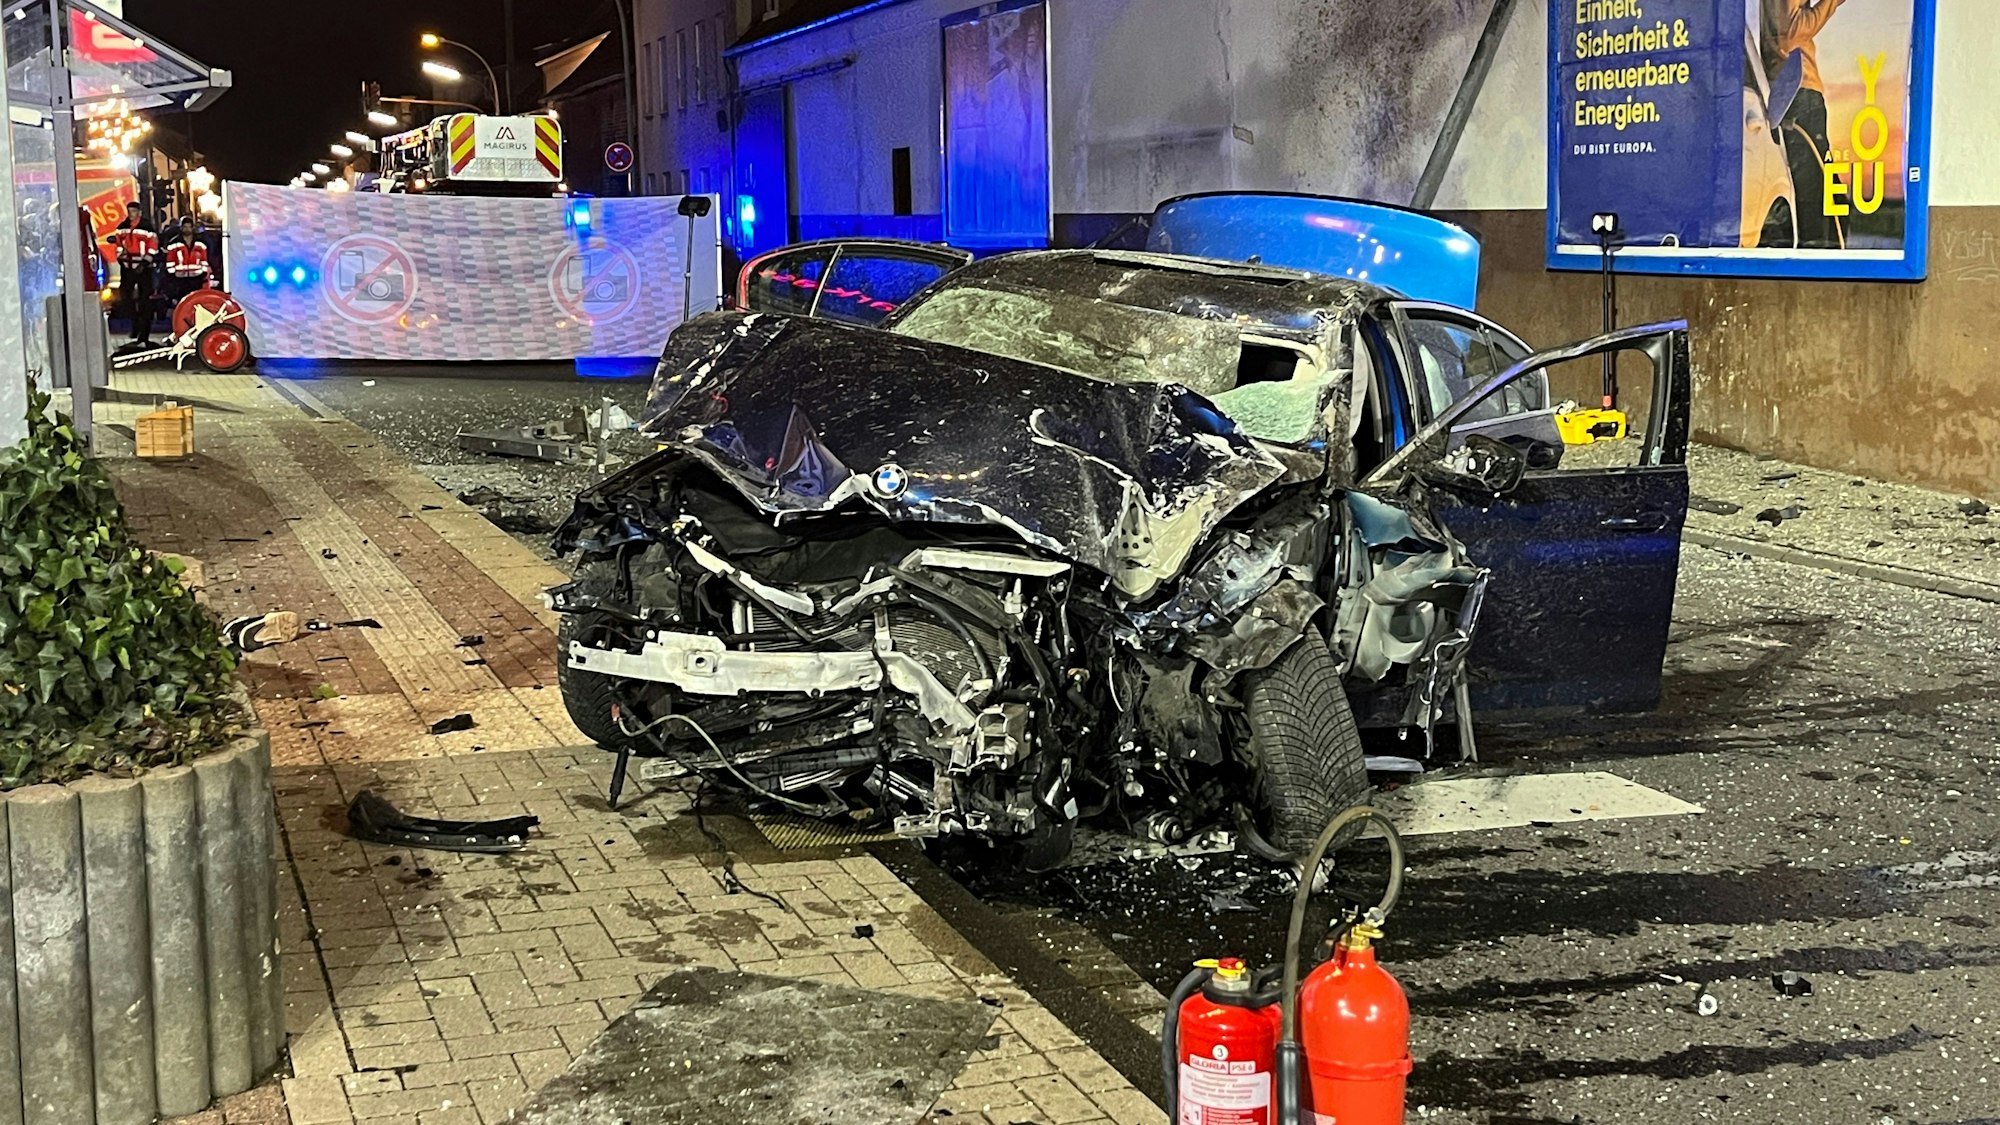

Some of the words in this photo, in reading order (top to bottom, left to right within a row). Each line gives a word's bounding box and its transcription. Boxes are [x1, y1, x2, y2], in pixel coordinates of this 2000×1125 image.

[1576, 0, 1642, 24] Einheit,
[1576, 20, 1669, 59] Sicherheit
[1673, 18, 1690, 48] &
[1575, 59, 1690, 92] erneuerbare
[1575, 94, 1660, 131] Energien.
[483, 142, 527, 150] MAGIRUS
[1573, 144, 1587, 155] DU
[1588, 143, 1611, 155] BIST
[1613, 141, 1657, 154] EUROPA.
[1824, 150, 1850, 162] ARE
[1823, 161, 1885, 216] EU
[1217, 1048, 1223, 1057] 3
[1191, 1057, 1226, 1070] GLORIA
